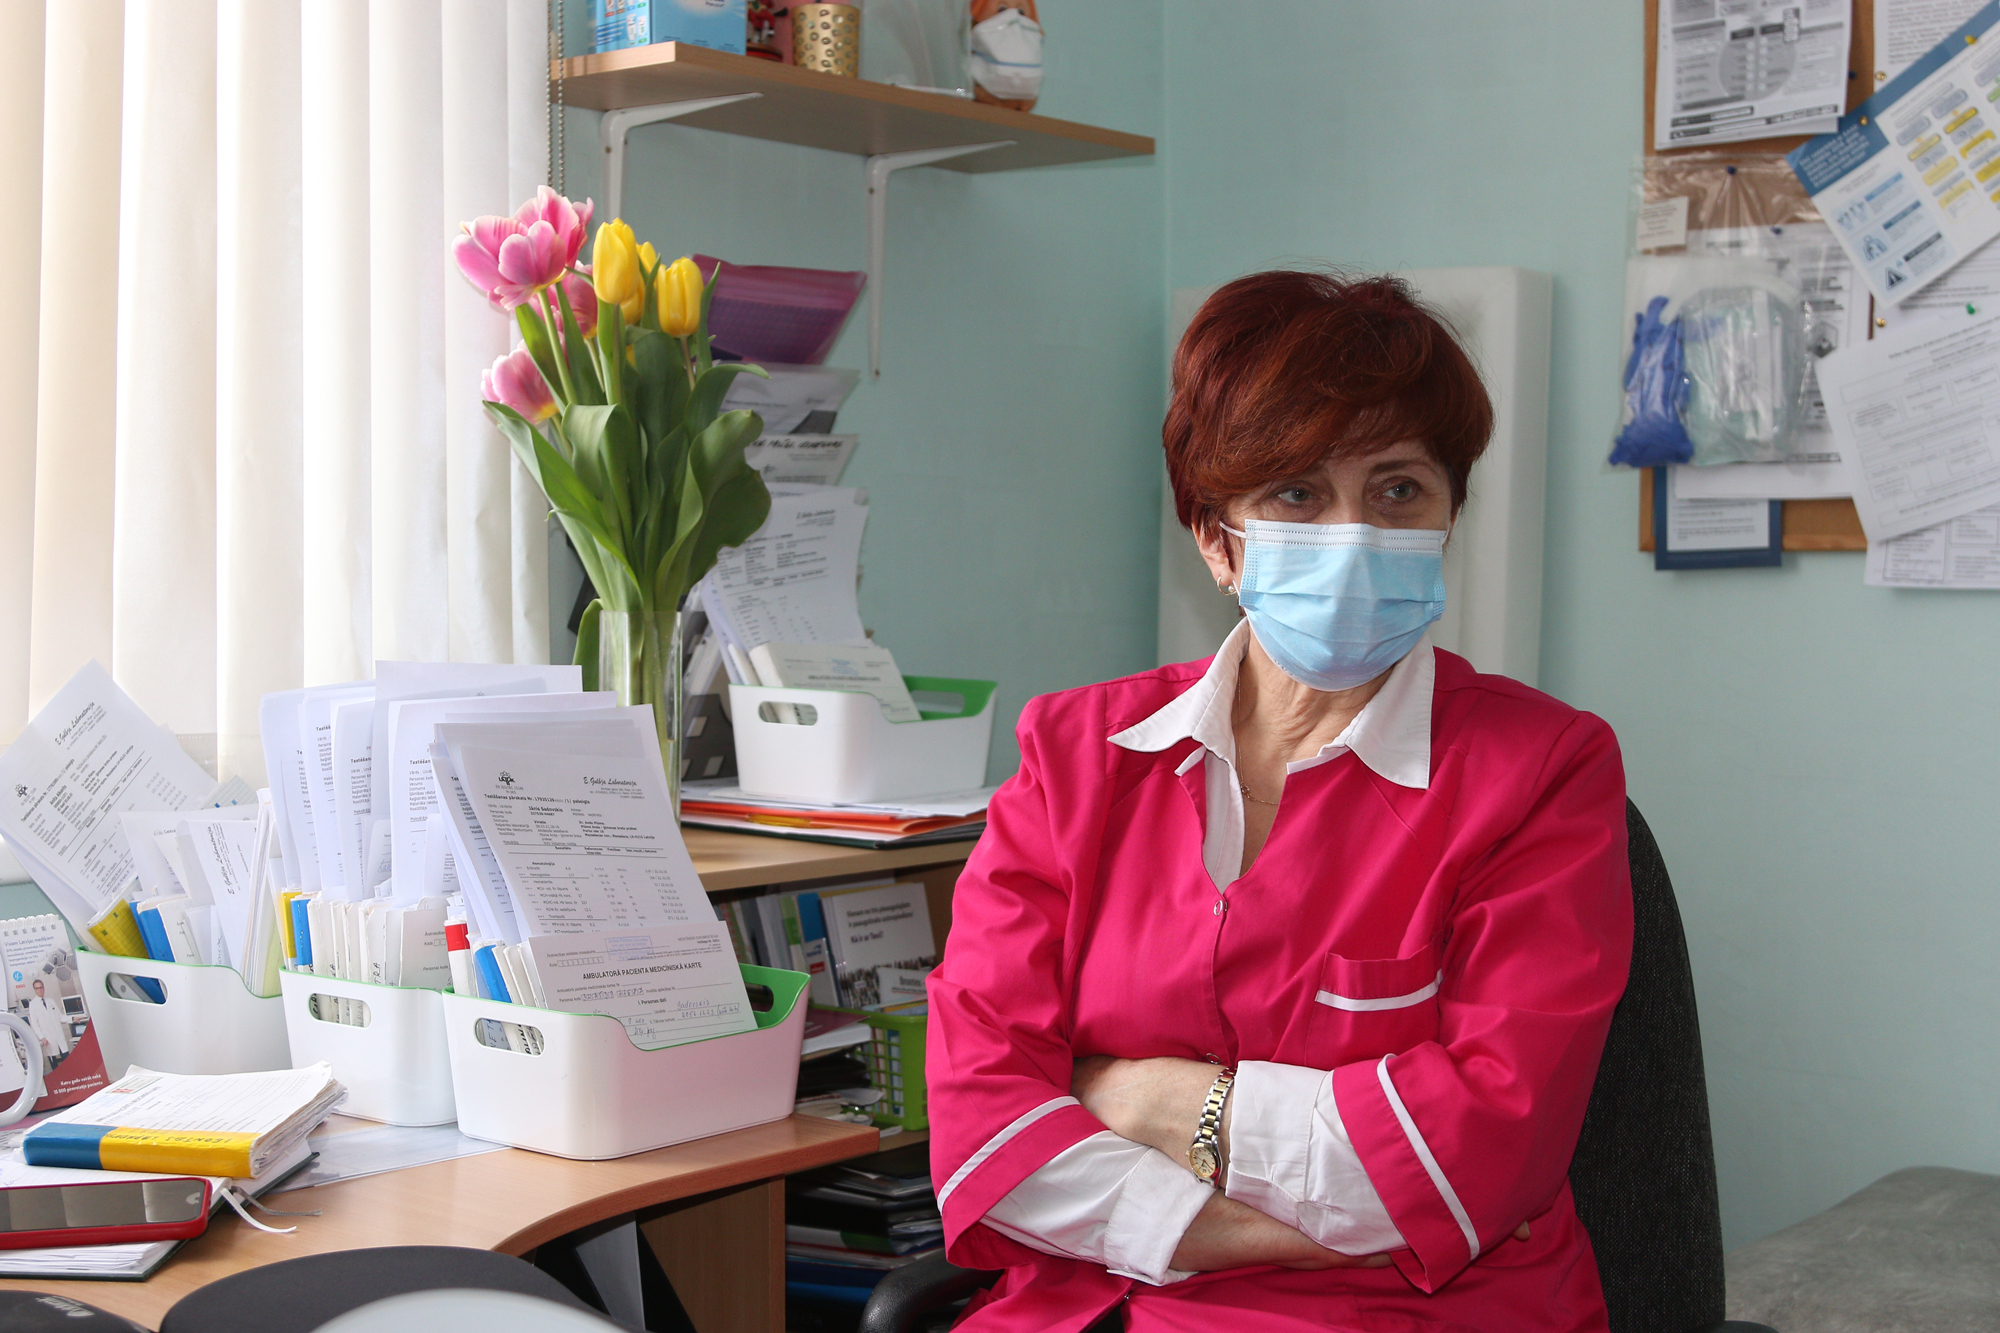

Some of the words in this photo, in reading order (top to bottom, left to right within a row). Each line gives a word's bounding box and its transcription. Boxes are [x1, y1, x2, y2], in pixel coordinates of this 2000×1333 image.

[608, 778, 637, 787] Laboratorija
[583, 968, 621, 980] AMBULATORĀ
[622, 966, 649, 976] PACIENTA
[650, 963, 683, 973] MEDICĪNISKĀ
[684, 961, 702, 970] KARTE
